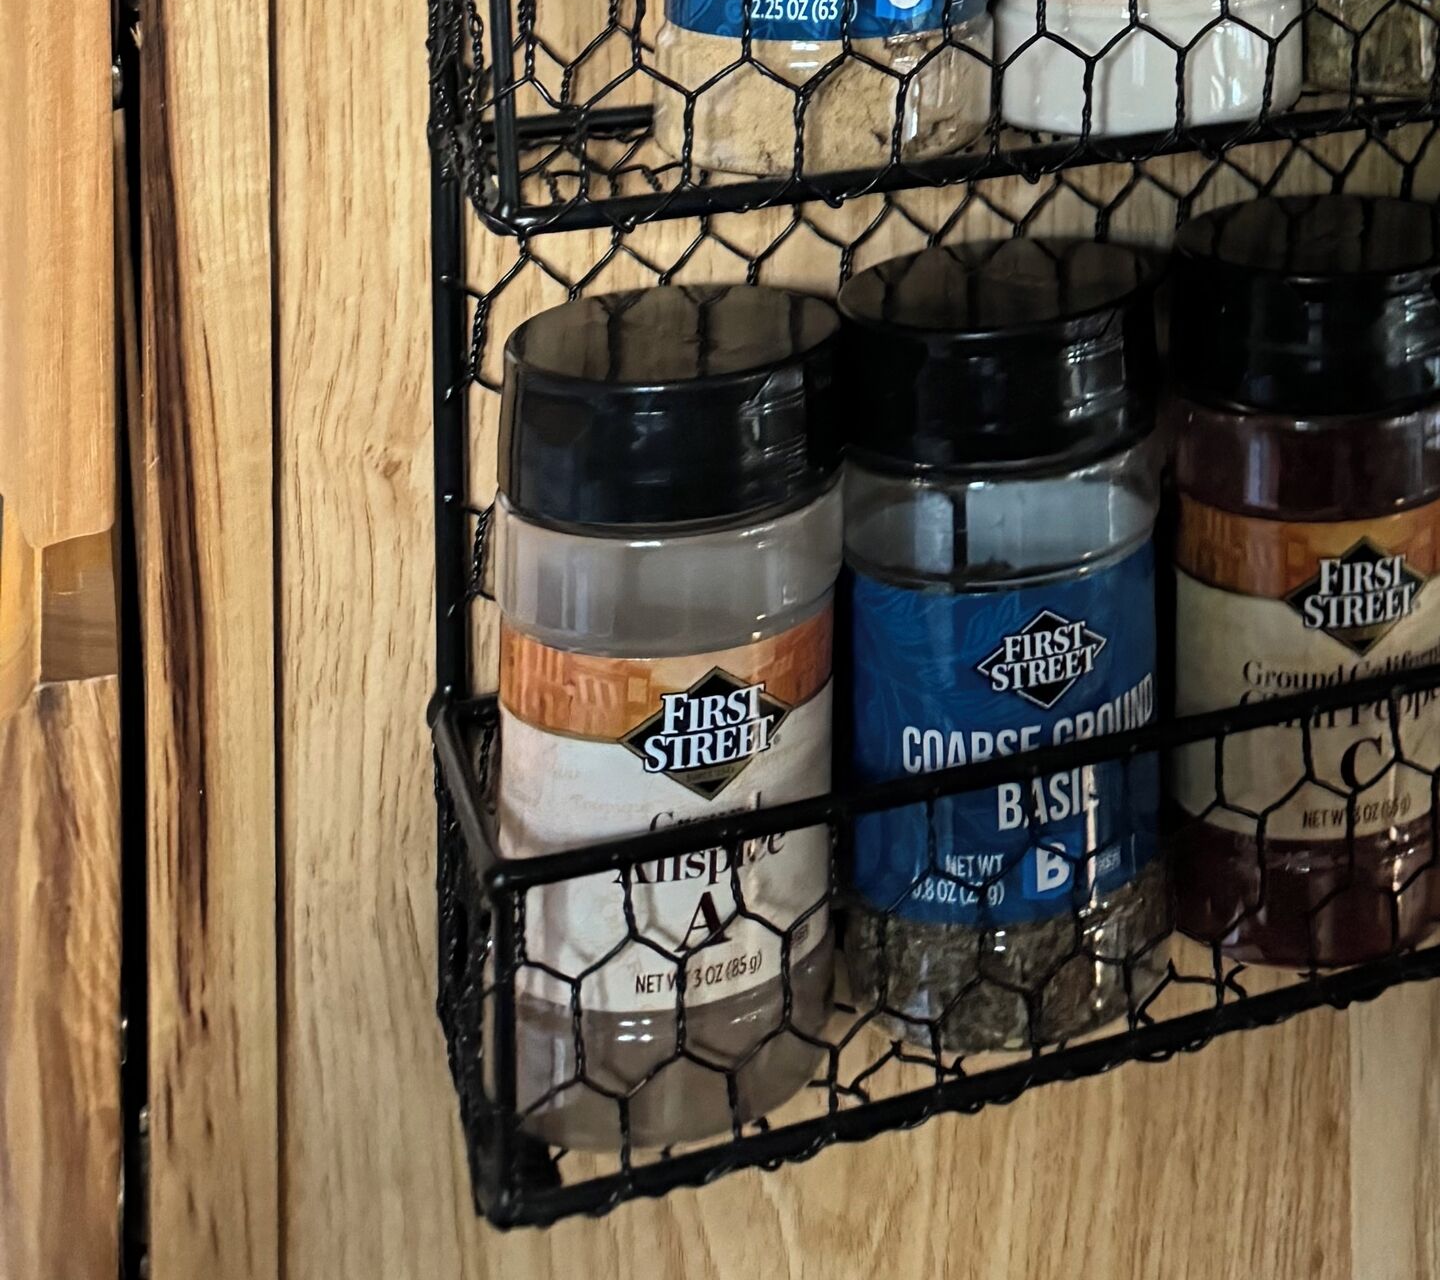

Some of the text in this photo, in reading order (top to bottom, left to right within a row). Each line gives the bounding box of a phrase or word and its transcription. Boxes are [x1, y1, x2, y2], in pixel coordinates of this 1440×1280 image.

[1319, 554, 1407, 596] FIRST
[1303, 582, 1415, 630] STREET
[1003, 620, 1087, 663] FIRST
[990, 643, 1099, 693] STREET
[1243, 658, 1345, 688] Ground
[661, 683, 767, 737] FIRST
[643, 715, 775, 774] STREET
[902, 724, 1043, 777] COARSE
[1340, 735, 1384, 790] C
[1302, 799, 1380, 830] NET OZ
[944, 851, 1006, 876] NET WT
[1035, 841, 1071, 894] B
[935, 880, 957, 902] OZ
[673, 891, 732, 954] A
[635, 963, 724, 996] NET OZ
